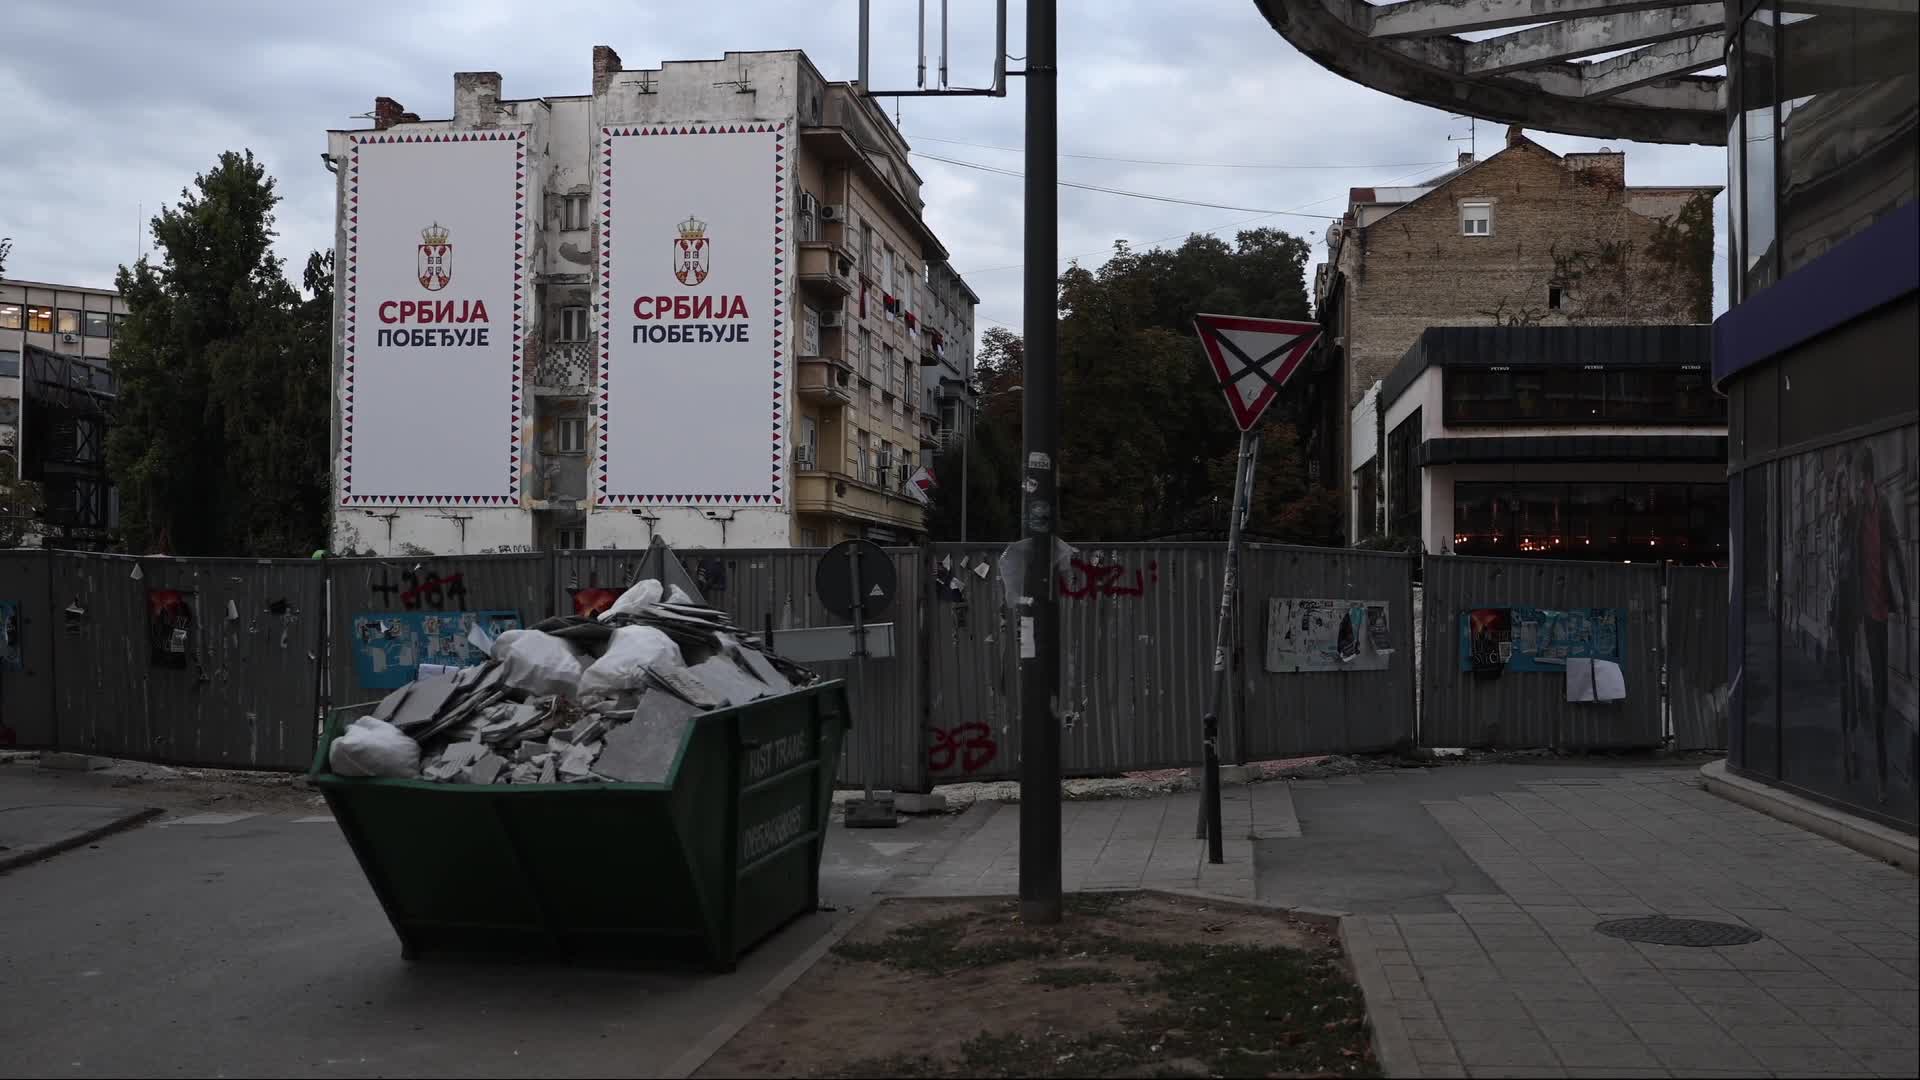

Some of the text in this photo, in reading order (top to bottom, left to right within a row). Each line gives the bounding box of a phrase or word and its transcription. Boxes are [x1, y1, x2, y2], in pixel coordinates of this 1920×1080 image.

[379, 300, 489, 324] СРБИЈА
[633, 295, 749, 320] СРБИЈА
[378, 328, 489, 347] ПОБЕЂУЈЕ
[633, 324, 749, 343] ПОБЕЂУЈЕ
